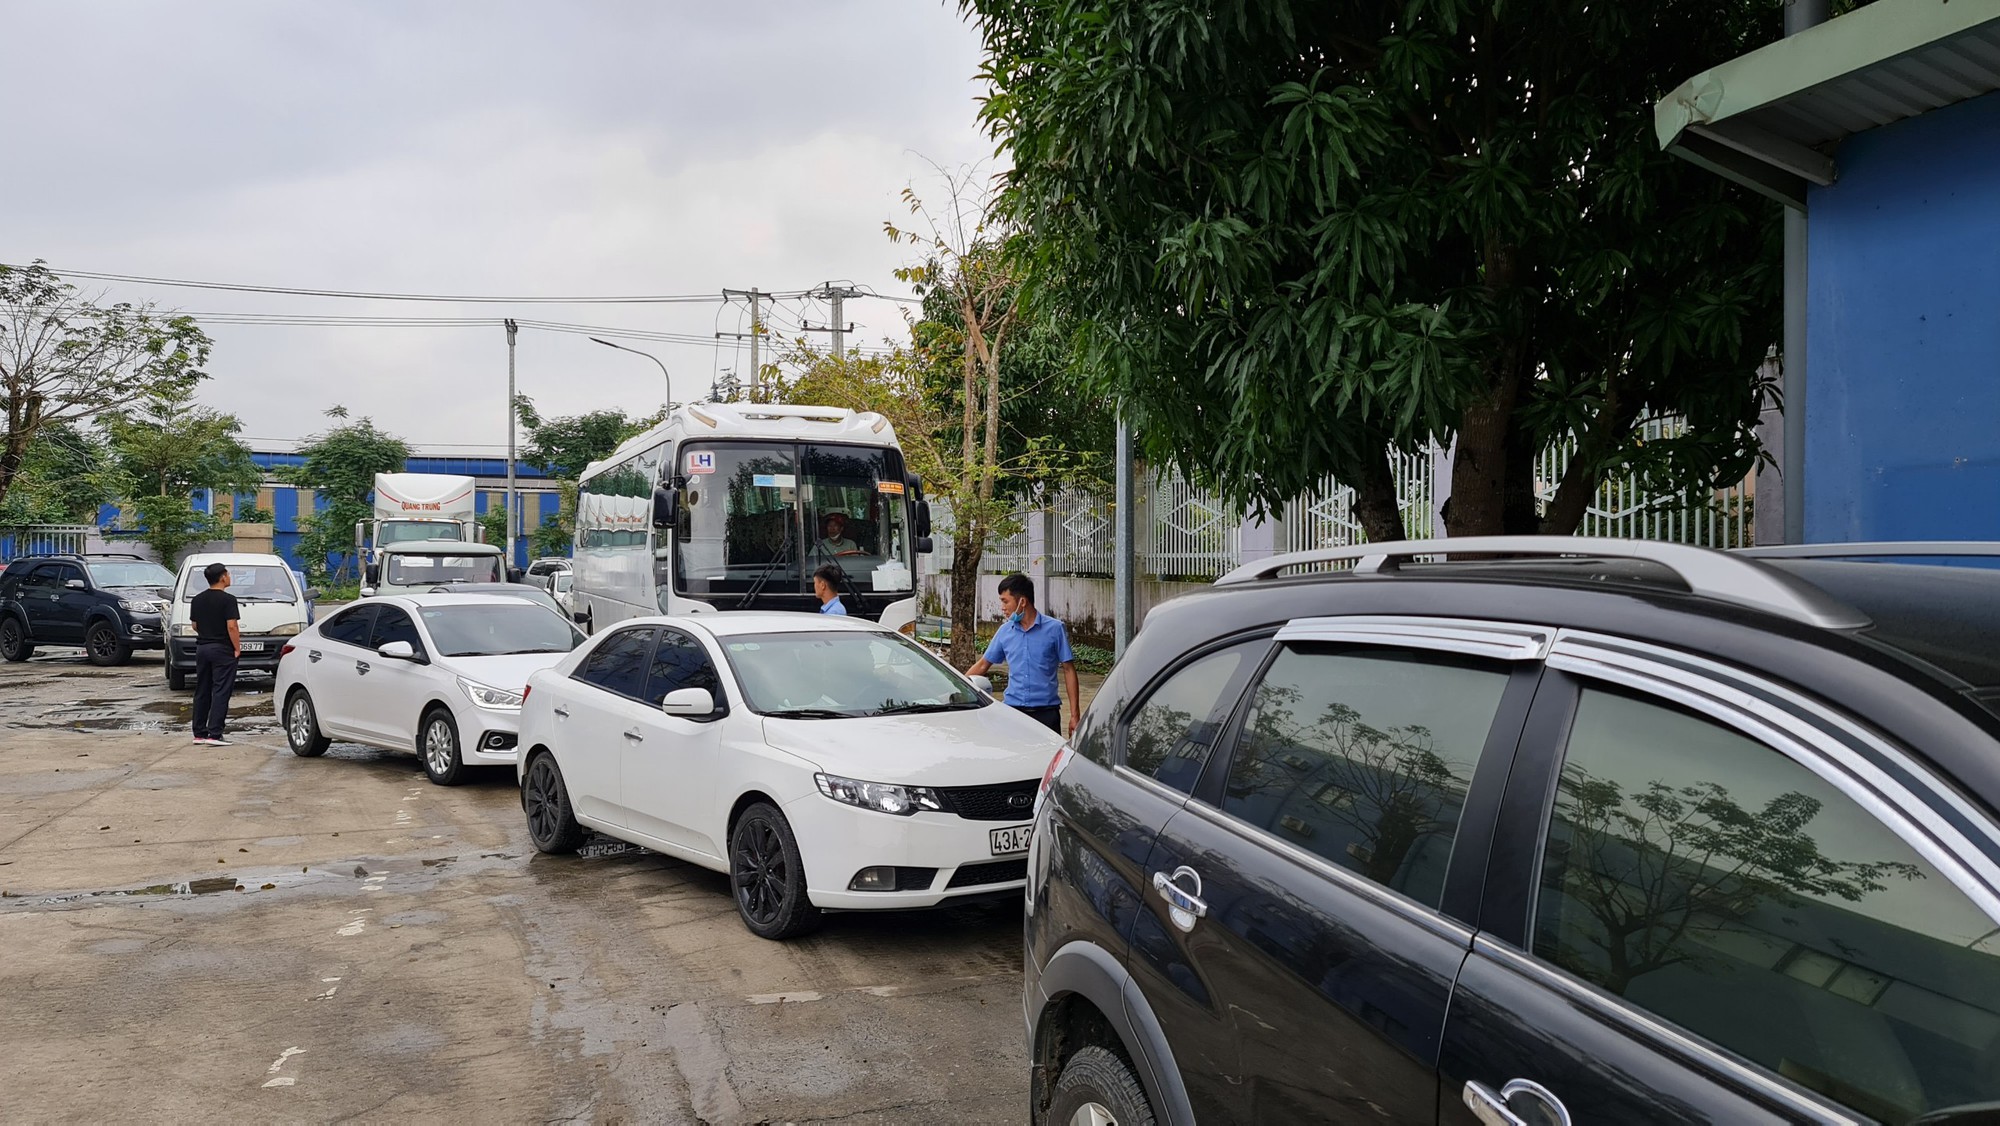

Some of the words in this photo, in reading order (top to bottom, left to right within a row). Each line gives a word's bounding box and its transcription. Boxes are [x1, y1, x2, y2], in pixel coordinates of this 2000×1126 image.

[691, 454, 711, 467] LH
[402, 501, 420, 511] QUANG
[422, 502, 440, 510] TRUNG
